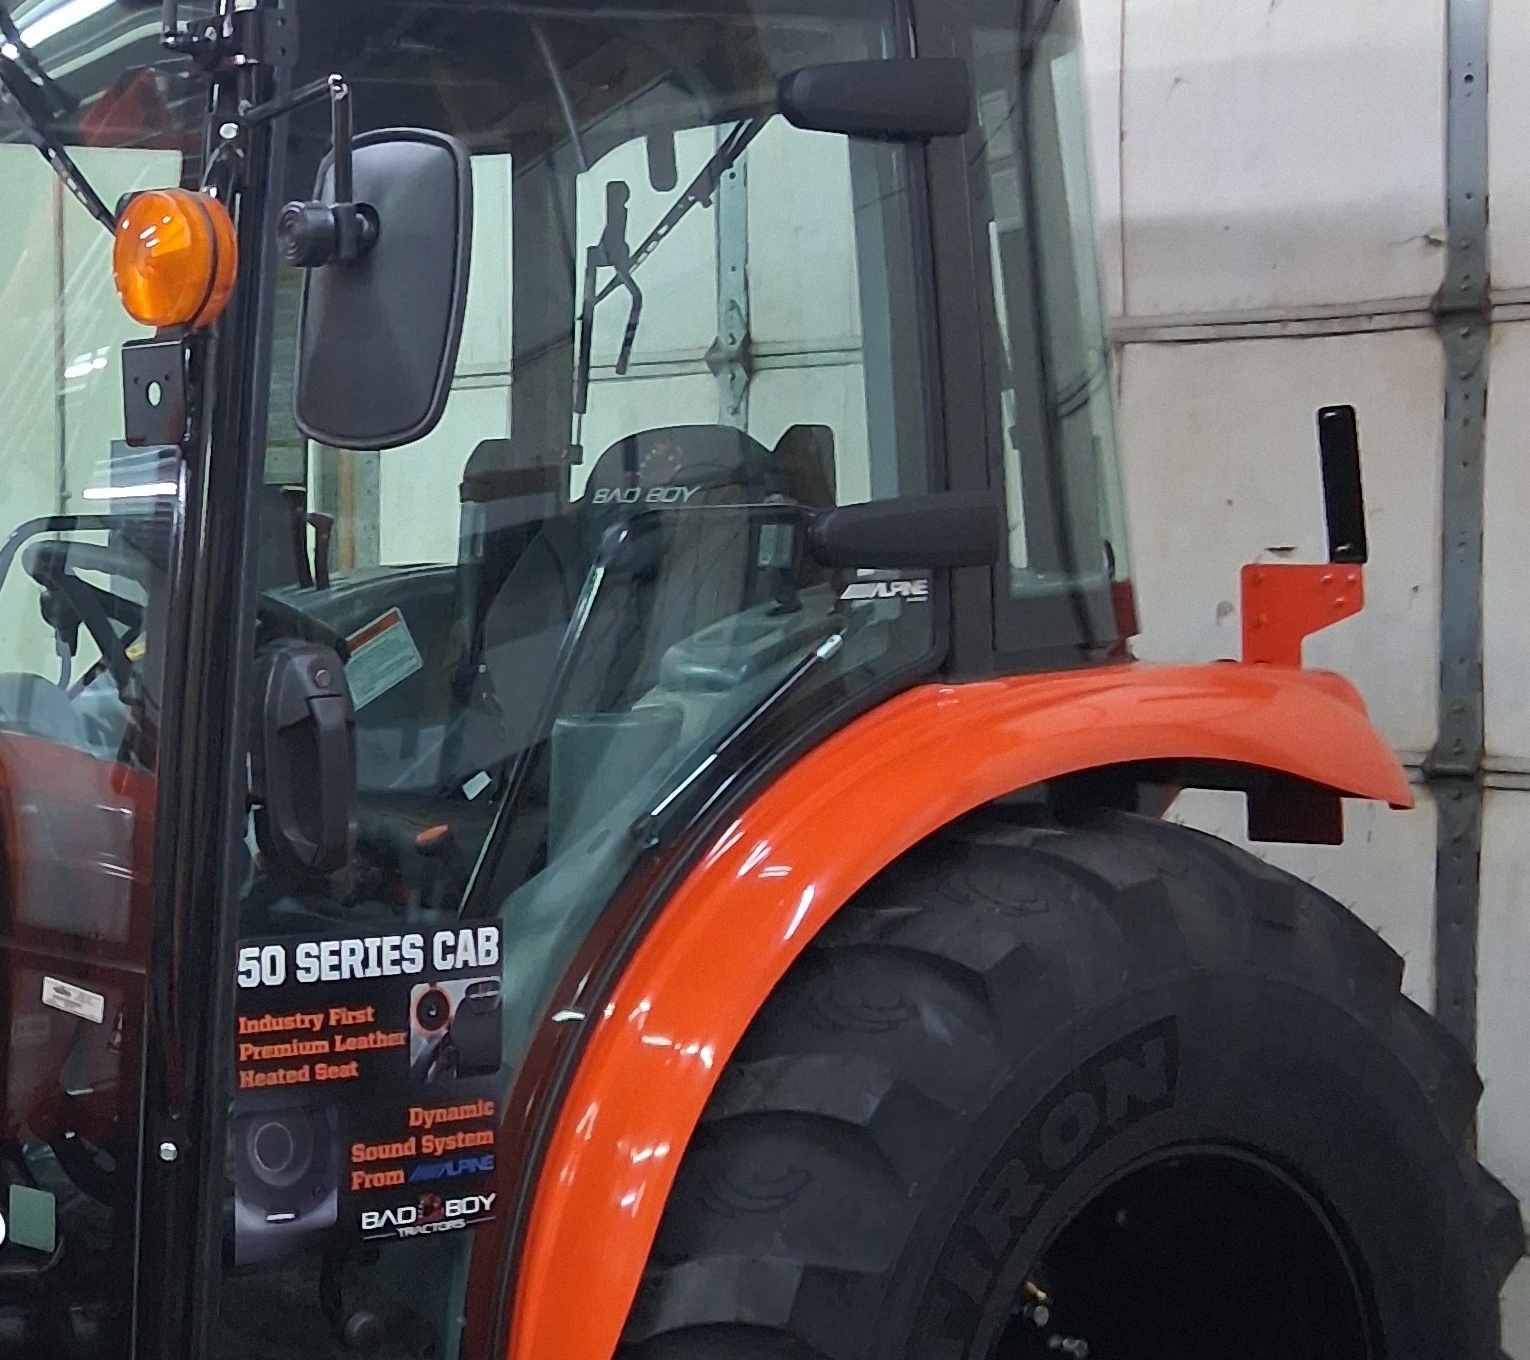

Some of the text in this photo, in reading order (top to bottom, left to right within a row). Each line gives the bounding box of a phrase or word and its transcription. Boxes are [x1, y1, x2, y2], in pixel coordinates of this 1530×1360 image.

[592, 484, 703, 505] BAD BOY
[237, 926, 501, 988] 50 SERIES CAB
[238, 1005, 376, 1035] Industry First
[238, 1030, 407, 1062] Premium Leather
[239, 1060, 359, 1089] Heated Seat
[408, 1099, 495, 1128] Dynamic
[351, 1129, 495, 1163] Sound System
[351, 1169, 405, 1191] From
[361, 1193, 497, 1230] BAD BOY
[396, 1218, 467, 1238] TRACTORS
